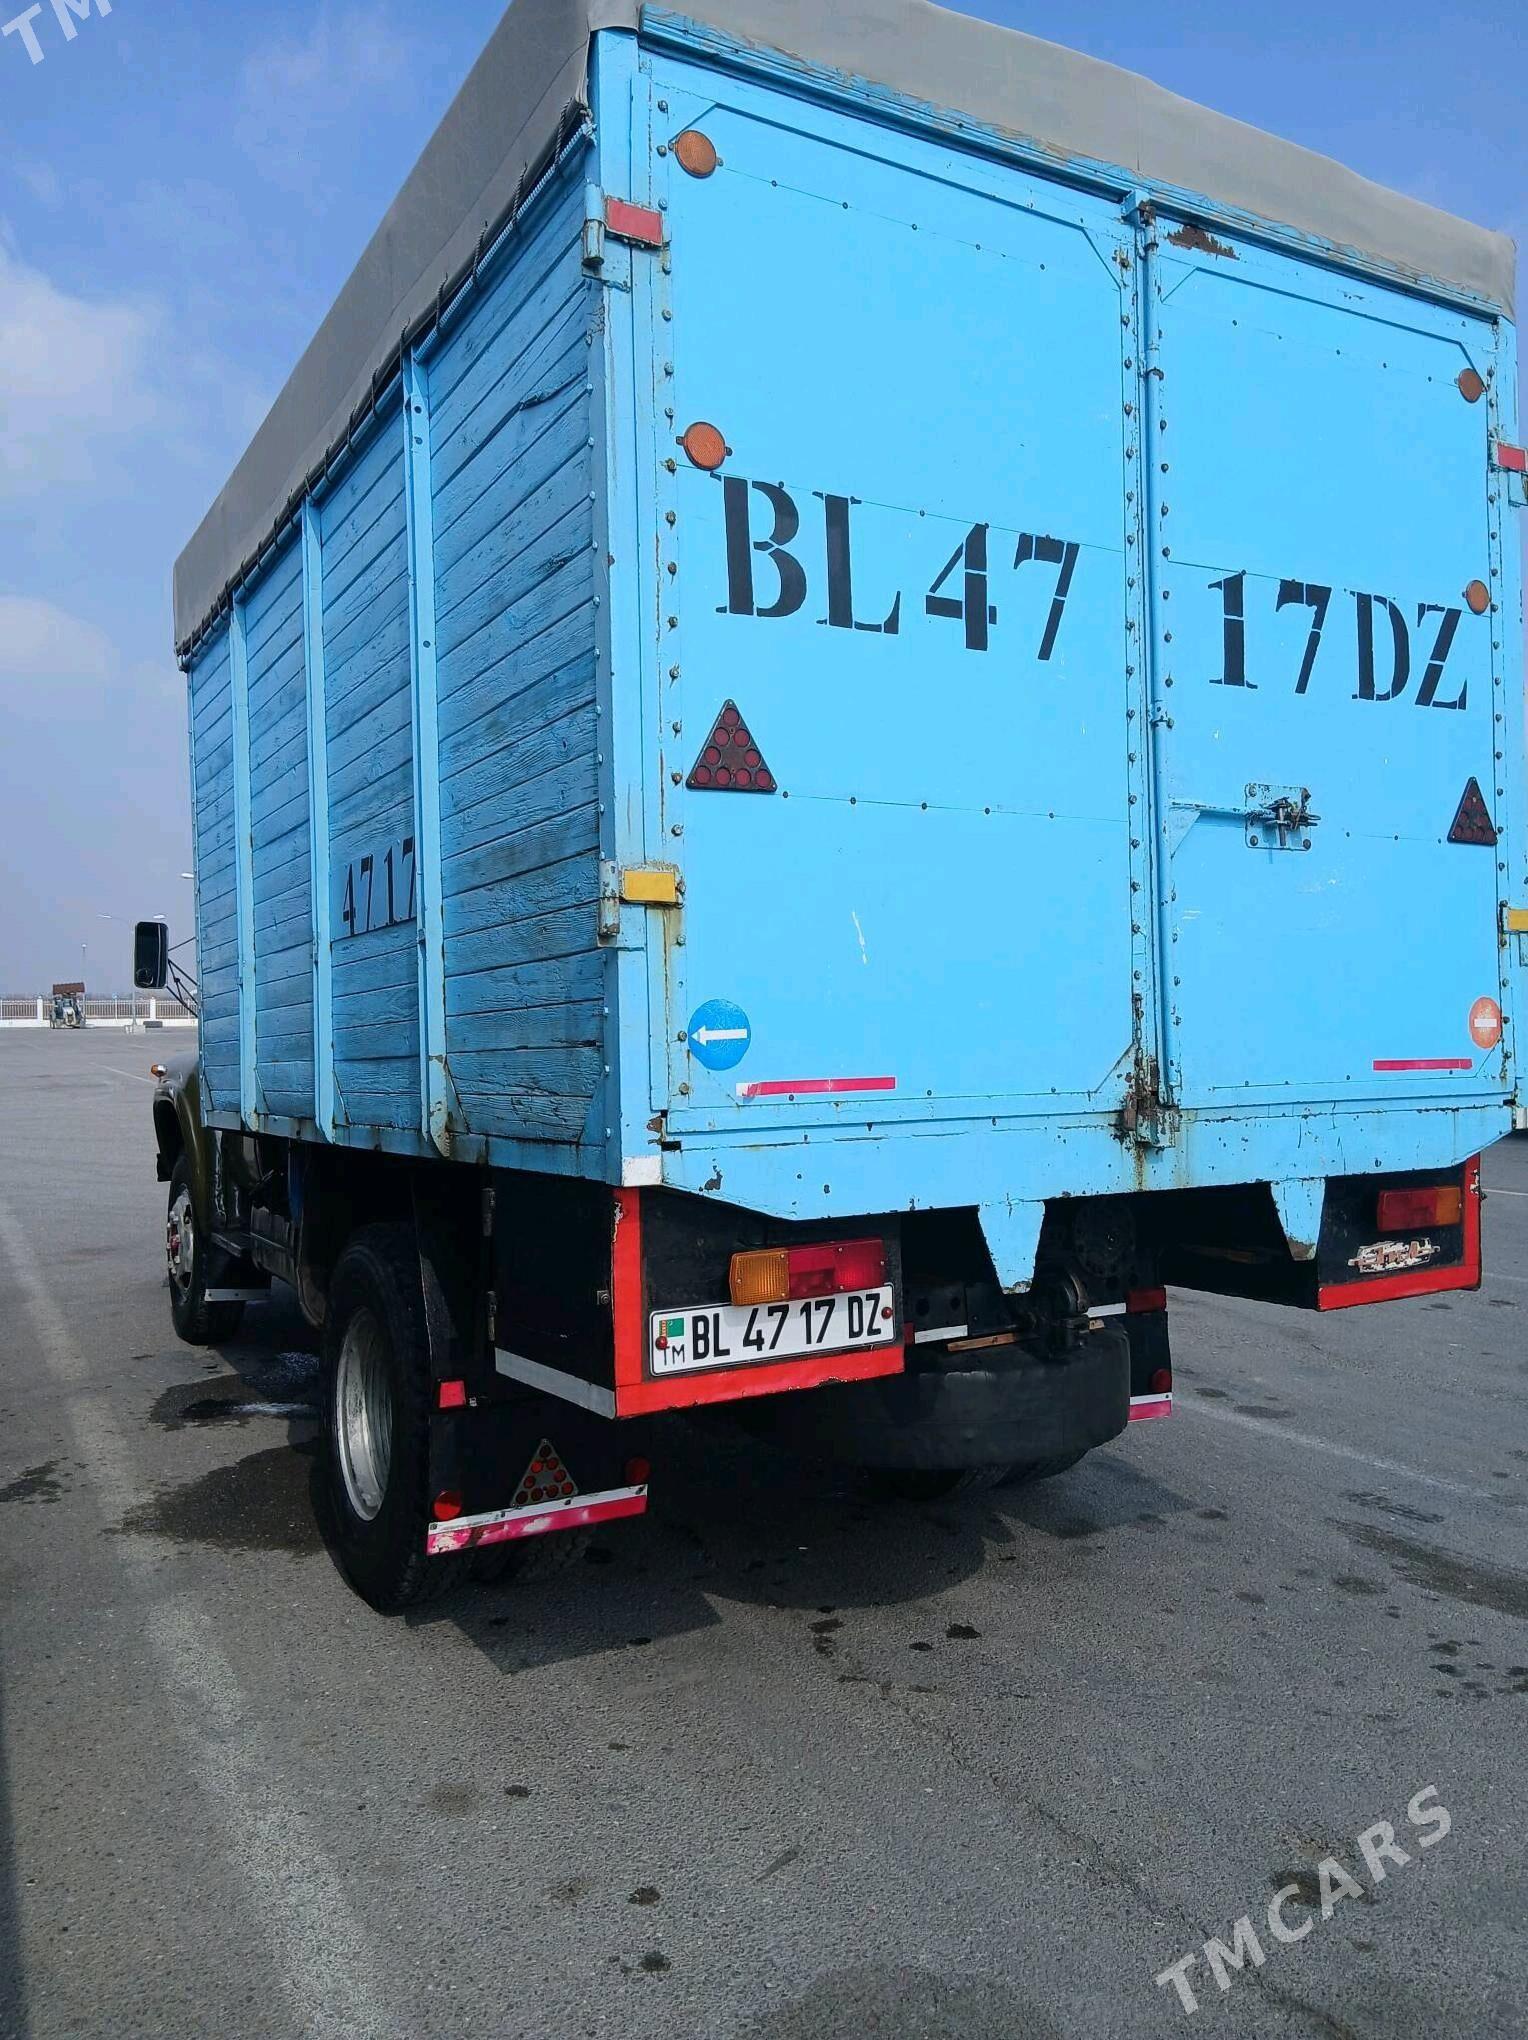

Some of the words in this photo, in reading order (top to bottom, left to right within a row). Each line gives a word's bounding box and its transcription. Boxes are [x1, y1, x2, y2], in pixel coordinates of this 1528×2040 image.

[691, 1314, 731, 1361] BL
[847, 1293, 882, 1339] DZ
[662, 1343, 686, 1367] TM
